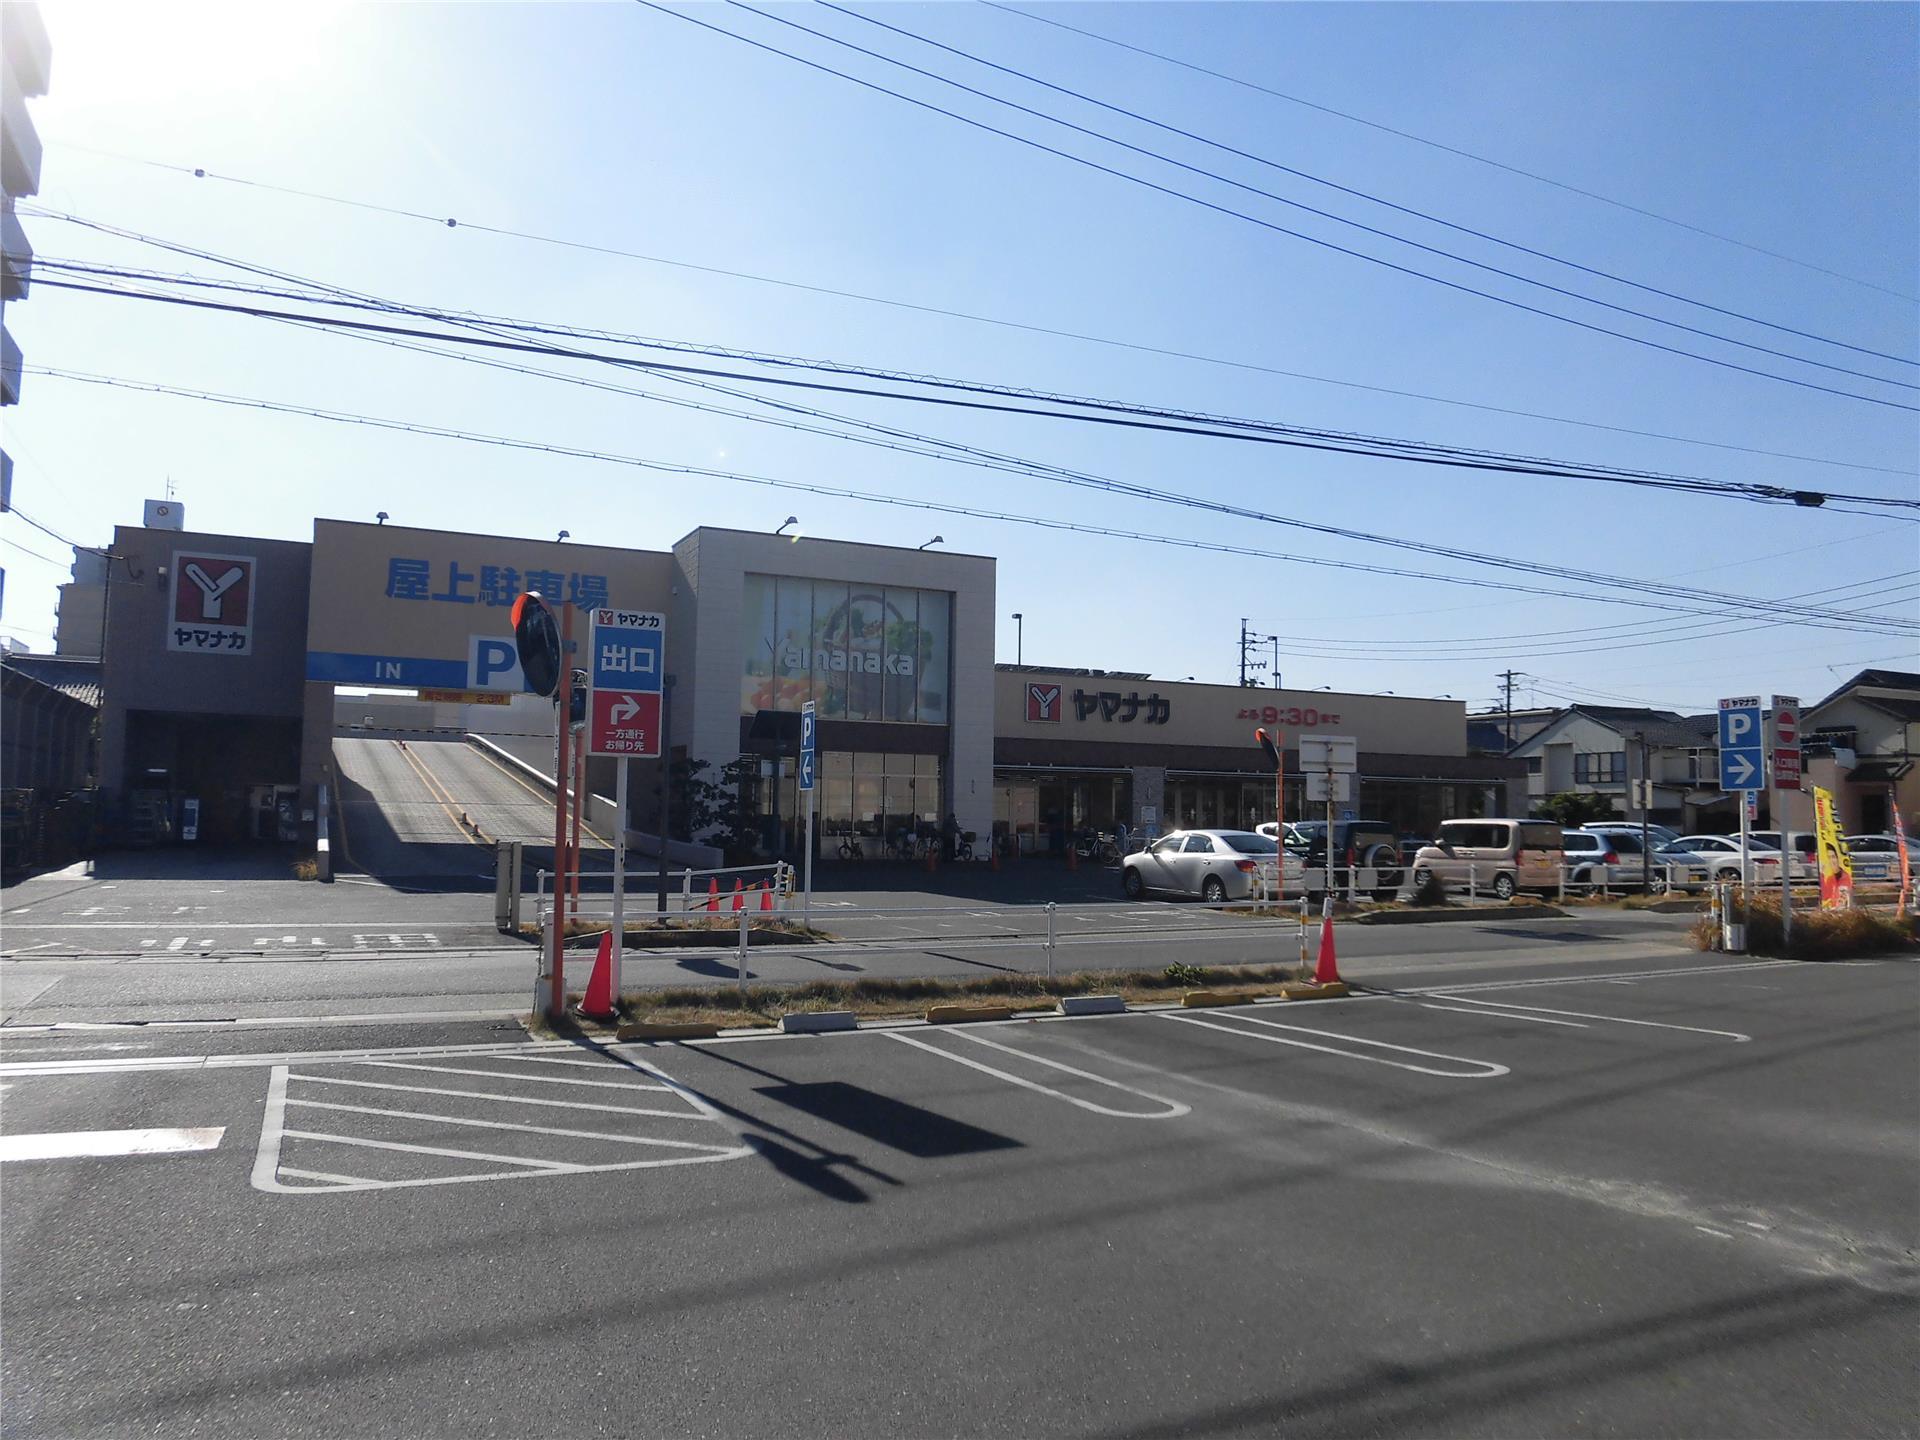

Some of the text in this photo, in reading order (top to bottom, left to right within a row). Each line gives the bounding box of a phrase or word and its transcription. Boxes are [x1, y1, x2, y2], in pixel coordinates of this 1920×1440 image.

[385, 557, 609, 614] 屋上駐車場
[617, 613, 660, 628] ヤマナカ
[174, 627, 247, 650] ヤマナカ
[375, 661, 401, 679] IN
[476, 639, 517, 686] P
[600, 644, 655, 674] 出口
[1071, 688, 1170, 725] ヤマナカ
[605, 729, 645, 740] 一方通行
[803, 717, 812, 746] P
[1727, 713, 1752, 744] P
